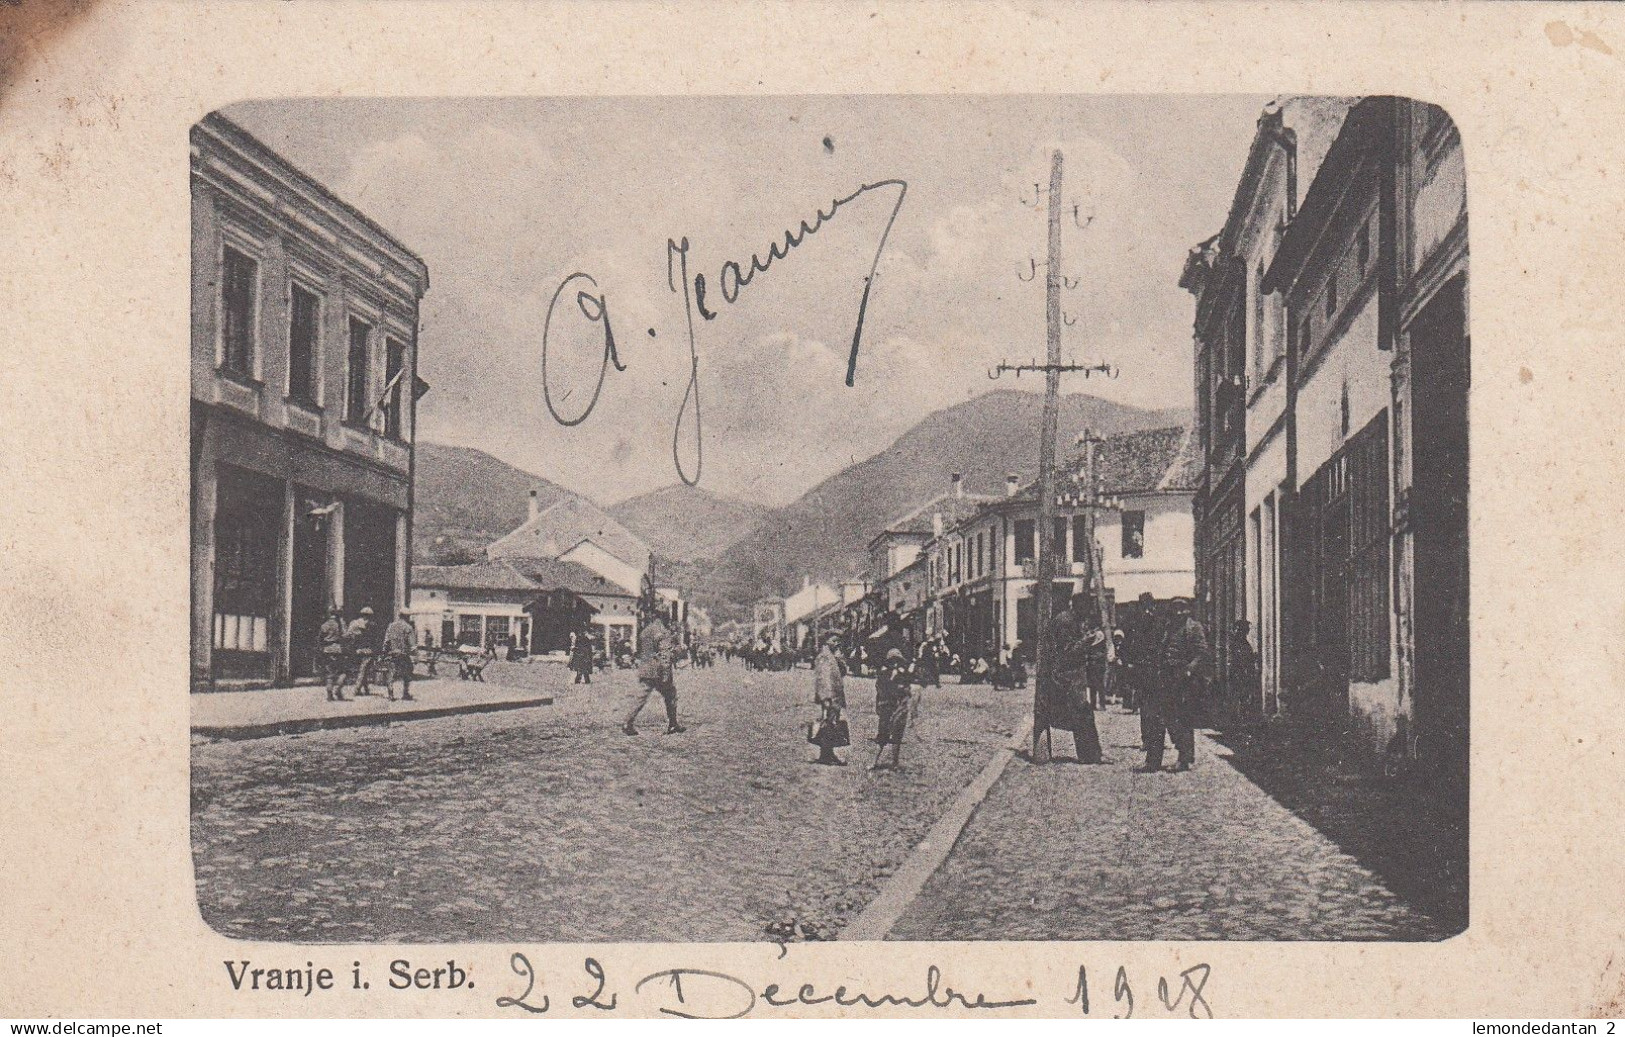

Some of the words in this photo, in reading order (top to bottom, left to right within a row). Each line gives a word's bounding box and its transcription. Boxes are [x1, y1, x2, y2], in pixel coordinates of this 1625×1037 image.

[223, 960, 334, 998] Vranje
[352, 960, 370, 990] i.
[388, 959, 475, 990] Serb.
